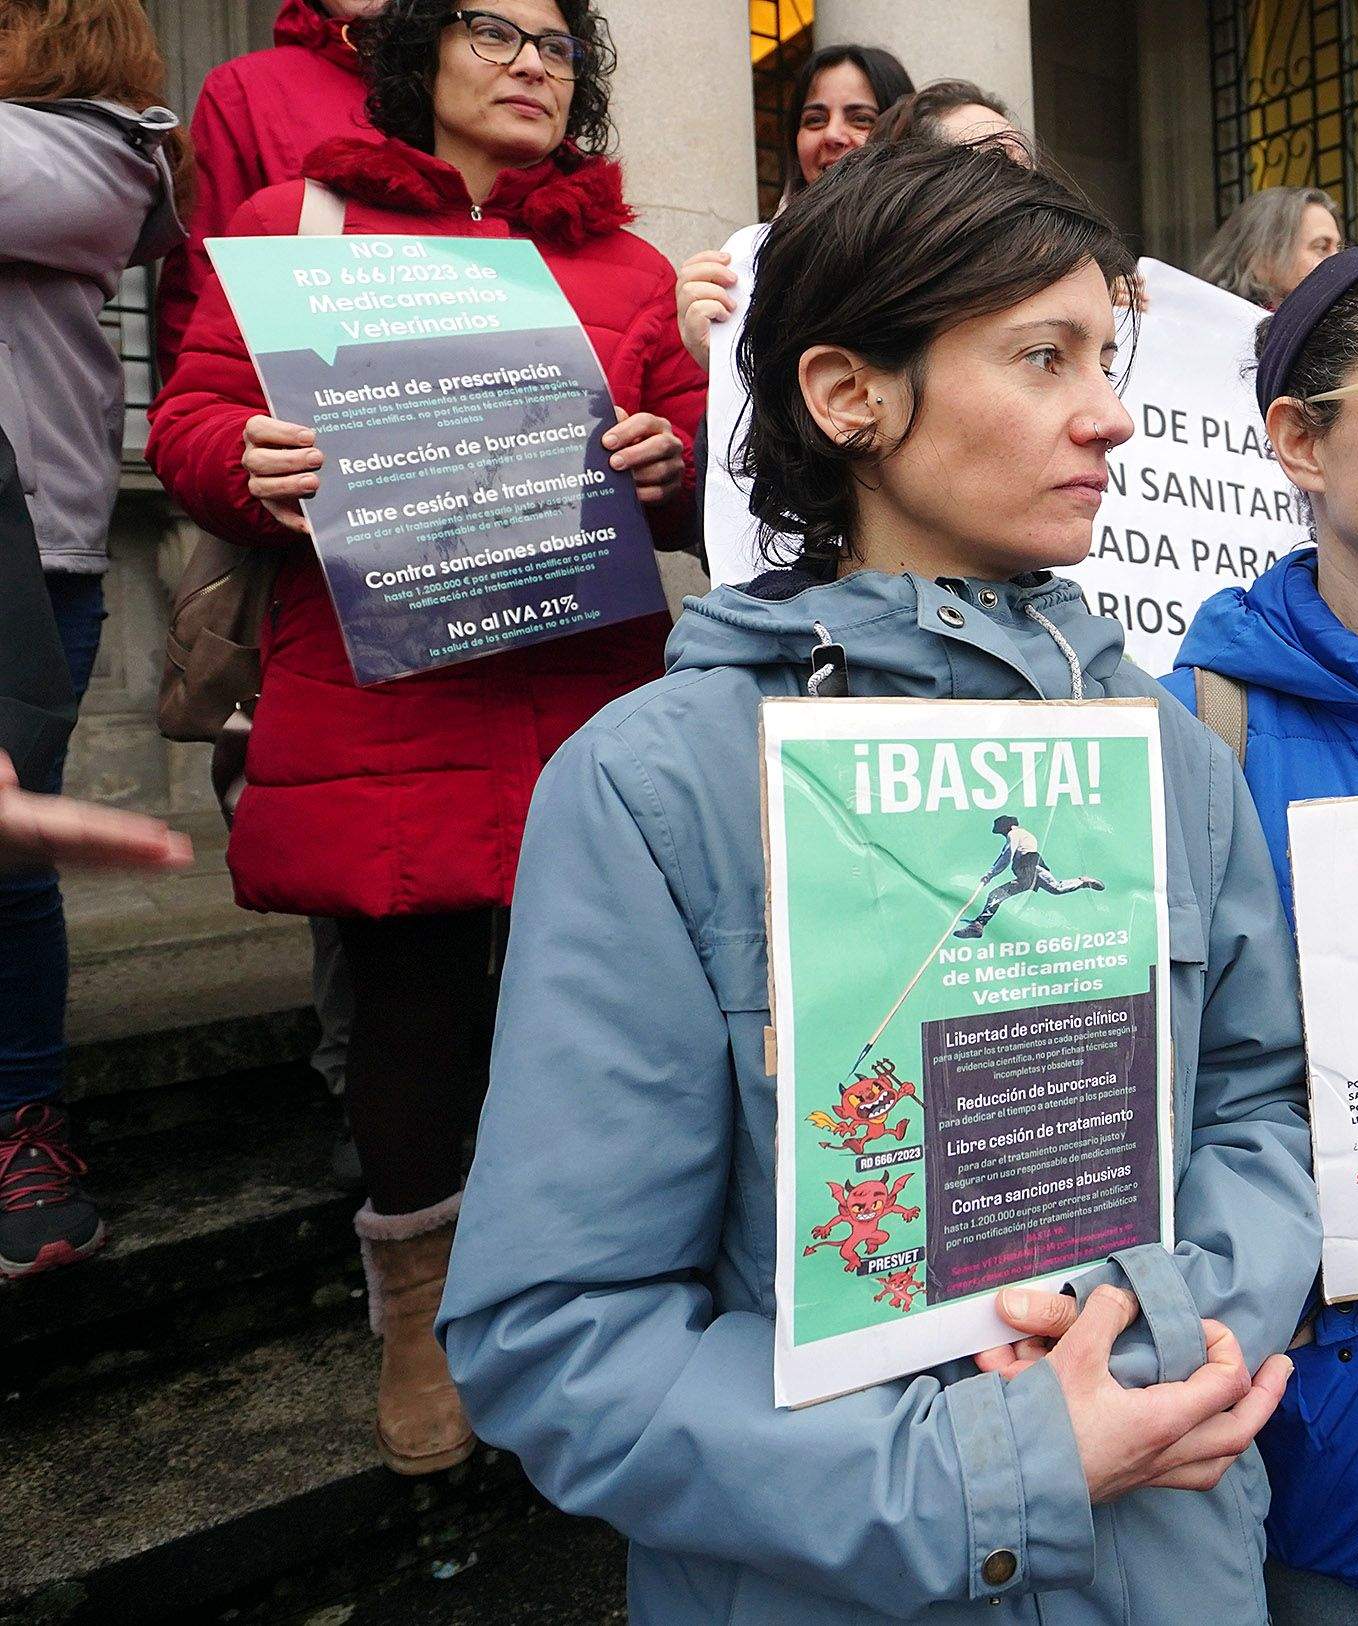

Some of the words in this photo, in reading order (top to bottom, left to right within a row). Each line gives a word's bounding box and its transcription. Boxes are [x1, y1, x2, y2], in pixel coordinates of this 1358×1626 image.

[350, 241, 394, 258] NO
[402, 241, 427, 257] al
[292, 268, 331, 286] RD
[340, 264, 458, 284] 666/2023
[464, 263, 497, 278] de
[309, 287, 507, 313] Medicamentos
[340, 312, 500, 339] Veterinarios
[314, 381, 400, 406] Libertad
[404, 379, 432, 394] de
[438, 363, 561, 396] prescripción
[339, 442, 450, 474] Reducción
[455, 439, 481, 456] de
[484, 422, 587, 451] burocracia
[1143, 404, 1188, 444] DE
[1202, 416, 1277, 461] PLA
[347, 507, 397, 526] Libre
[403, 491, 468, 516] cesión
[473, 487, 498, 504] de
[502, 468, 605, 498] tratamiento
[365, 564, 436, 588] Contra
[439, 544, 536, 574] sanciones
[540, 527, 616, 553] abusivas
[1089, 525, 1180, 570] ADA
[383, 590, 414, 602] hasta
[415, 578, 462, 595] 1.200.000
[463, 576, 470, 585] €
[471, 574, 488, 585] por
[490, 567, 522, 579] errores
[524, 563, 534, 572] al
[535, 556, 571, 569] notificar
[581, 551, 595, 562] por
[598, 548, 609, 556] no
[409, 590, 468, 609] notificación
[469, 587, 482, 596] de
[484, 575, 542, 593] tratamientos
[544, 563, 595, 579] antibióticos
[429, 648, 440, 656] la
[442, 640, 469, 654] salud
[470, 638, 483, 646] de
[485, 634, 499, 643] los
[501, 624, 543, 639] animales
[571, 614, 583, 622] un
[584, 610, 600, 619] lujo
[447, 621, 476, 639] No
[481, 612, 500, 631] al
[502, 605, 538, 626] IVA
[540, 594, 578, 617] 21%
[855, 741, 1101, 814] ¡BASTA!
[938, 946, 972, 964] NO
[977, 942, 994, 960] al
[1000, 941, 1030, 957] RD
[1035, 930, 1128, 954] 666/2023
[942, 970, 969, 986] de
[975, 954, 1127, 982] Medicamentos
[972, 978, 1103, 1005] Veterinarios
[946, 1024, 1007, 1047] Libertad
[1011, 1022, 1027, 1037] de
[1030, 1017, 1082, 1034] criterio
[1085, 1011, 1127, 1026] clínico
[938, 1118, 960, 1131] para
[962, 1111, 996, 1124] dedicar
[997, 1107, 1005, 1118] el
[1006, 1104, 1036, 1116] tiempo
[1044, 1096, 1078, 1109] atender
[1085, 1092, 1097, 1101] los
[1098, 1083, 1136, 1101] pacientes
[957, 1087, 1026, 1111] Reducción
[1028, 1084, 1044, 1098] de
[1047, 1074, 1116, 1094] burocracia
[947, 1139, 986, 1156] Libre
[989, 1127, 1033, 1148] cesión
[1036, 1123, 1053, 1138] de
[1056, 1109, 1133, 1134] tratamiento
[958, 1162, 979, 1175] para
[980, 1158, 996, 1168] dar
[998, 1154, 1006, 1164] el
[1007, 1146, 1057, 1162] tratamiento
[1059, 1136, 1098, 1151] necesario
[1099, 1132, 1120, 1145] justo
[1120, 1131, 1125, 1141] y
[860, 1157, 873, 1169] RD
[874, 1149, 920, 1166] 666/2023
[944, 1175, 985, 1190] asegurar
[987, 1172, 998, 1180] un
[1000, 1169, 1015, 1178] uso
[1016, 1156, 1067, 1175] responsable
[1068, 1153, 1080, 1163] de
[1080, 1142, 1136, 1160] medicamentos
[944, 1222, 968, 1234] hasta
[970, 1208, 1015, 1228] 1.200.000
[1016, 1205, 1041, 1216] euros
[1042, 1201, 1057, 1213] por
[1058, 1194, 1090, 1206] errores
[1092, 1189, 1099, 1199] al
[1100, 1183, 1132, 1197] notificar
[952, 1194, 1002, 1214] Contra
[1005, 1178, 1073, 1202] sanciones
[1076, 1165, 1130, 1186] abusivas
[946, 1238, 962, 1250] por
[963, 1235, 974, 1244] no
[976, 1221, 1026, 1240] notificación
[1026, 1217, 1038, 1229] de
[1039, 1207, 1092, 1225] tratamientos
[1093, 1195, 1137, 1212] antibióticos
[868, 1248, 918, 1273] PRESVET
